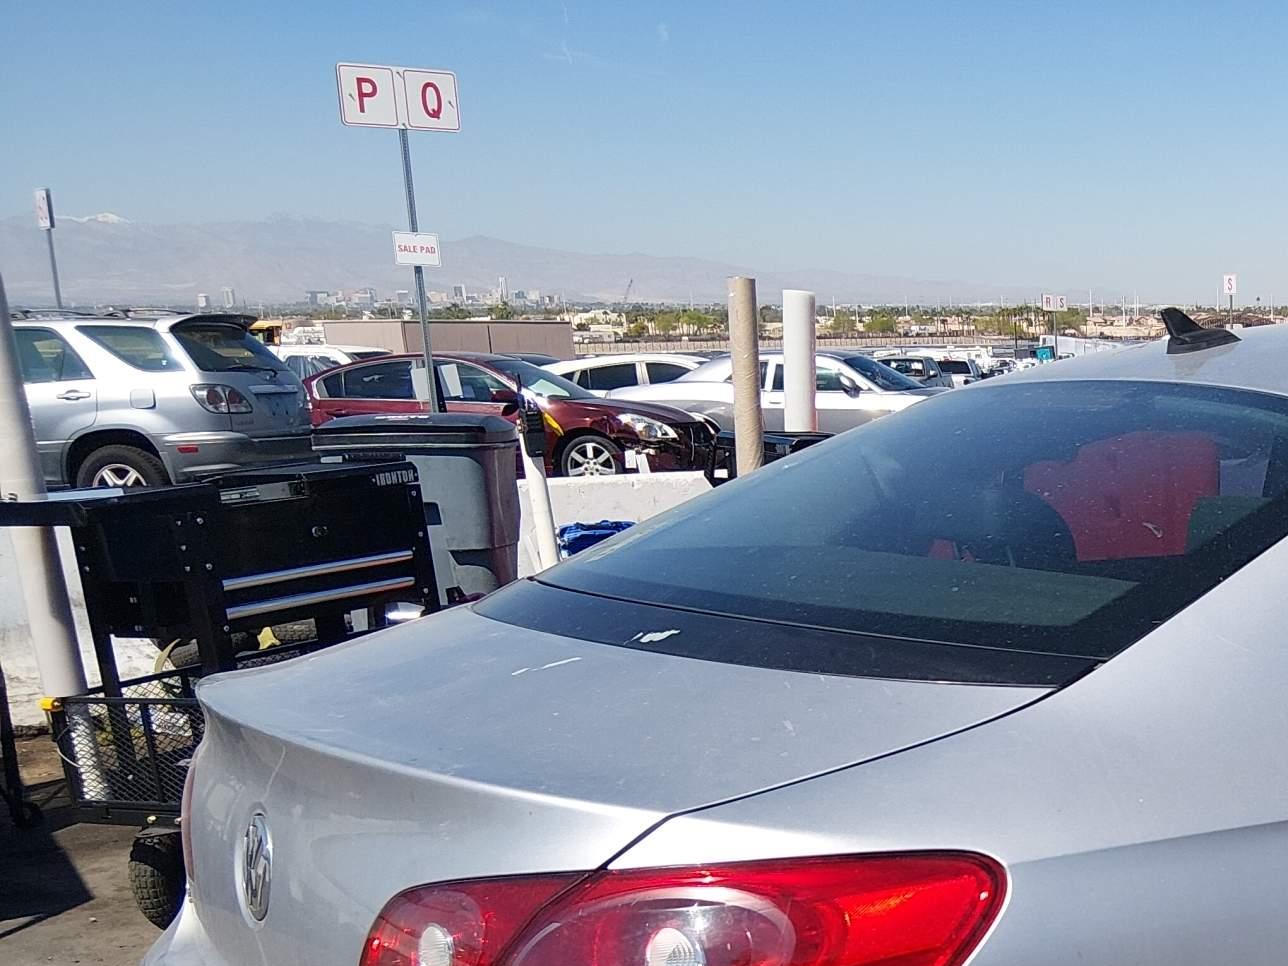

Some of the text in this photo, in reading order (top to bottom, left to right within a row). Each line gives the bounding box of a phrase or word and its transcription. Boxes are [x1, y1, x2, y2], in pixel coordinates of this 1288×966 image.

[356, 77, 377, 113] P
[421, 82, 442, 120] Q
[397, 244, 436, 254] SALE PAD
[1227, 277, 1233, 291] S
